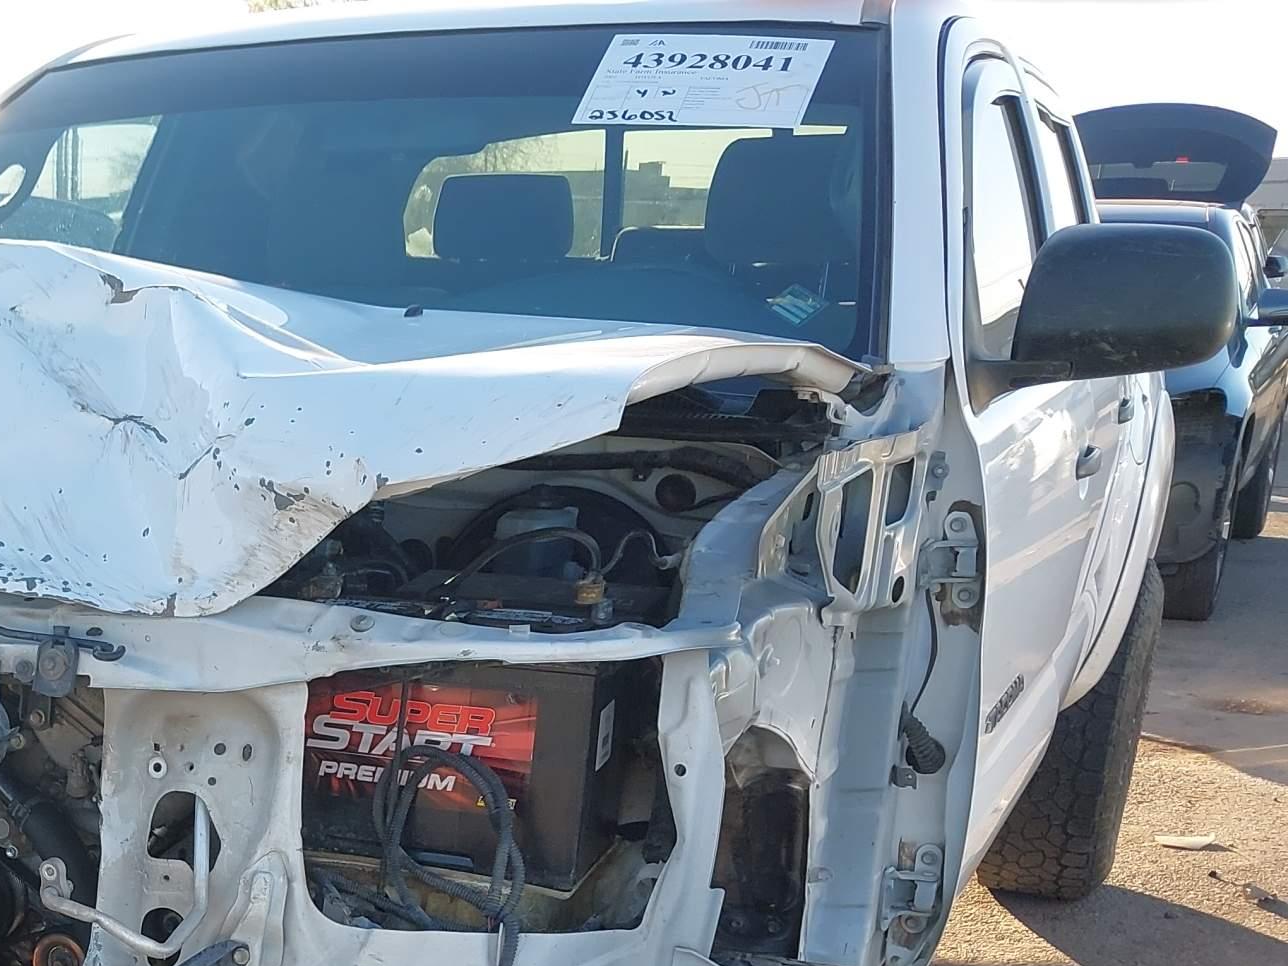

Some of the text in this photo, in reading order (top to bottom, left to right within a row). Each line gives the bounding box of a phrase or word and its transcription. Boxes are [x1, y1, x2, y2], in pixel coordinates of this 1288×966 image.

[623, 52, 793, 72] 43928041
[329, 691, 496, 736] SUPER
[306, 714, 494, 755] START
